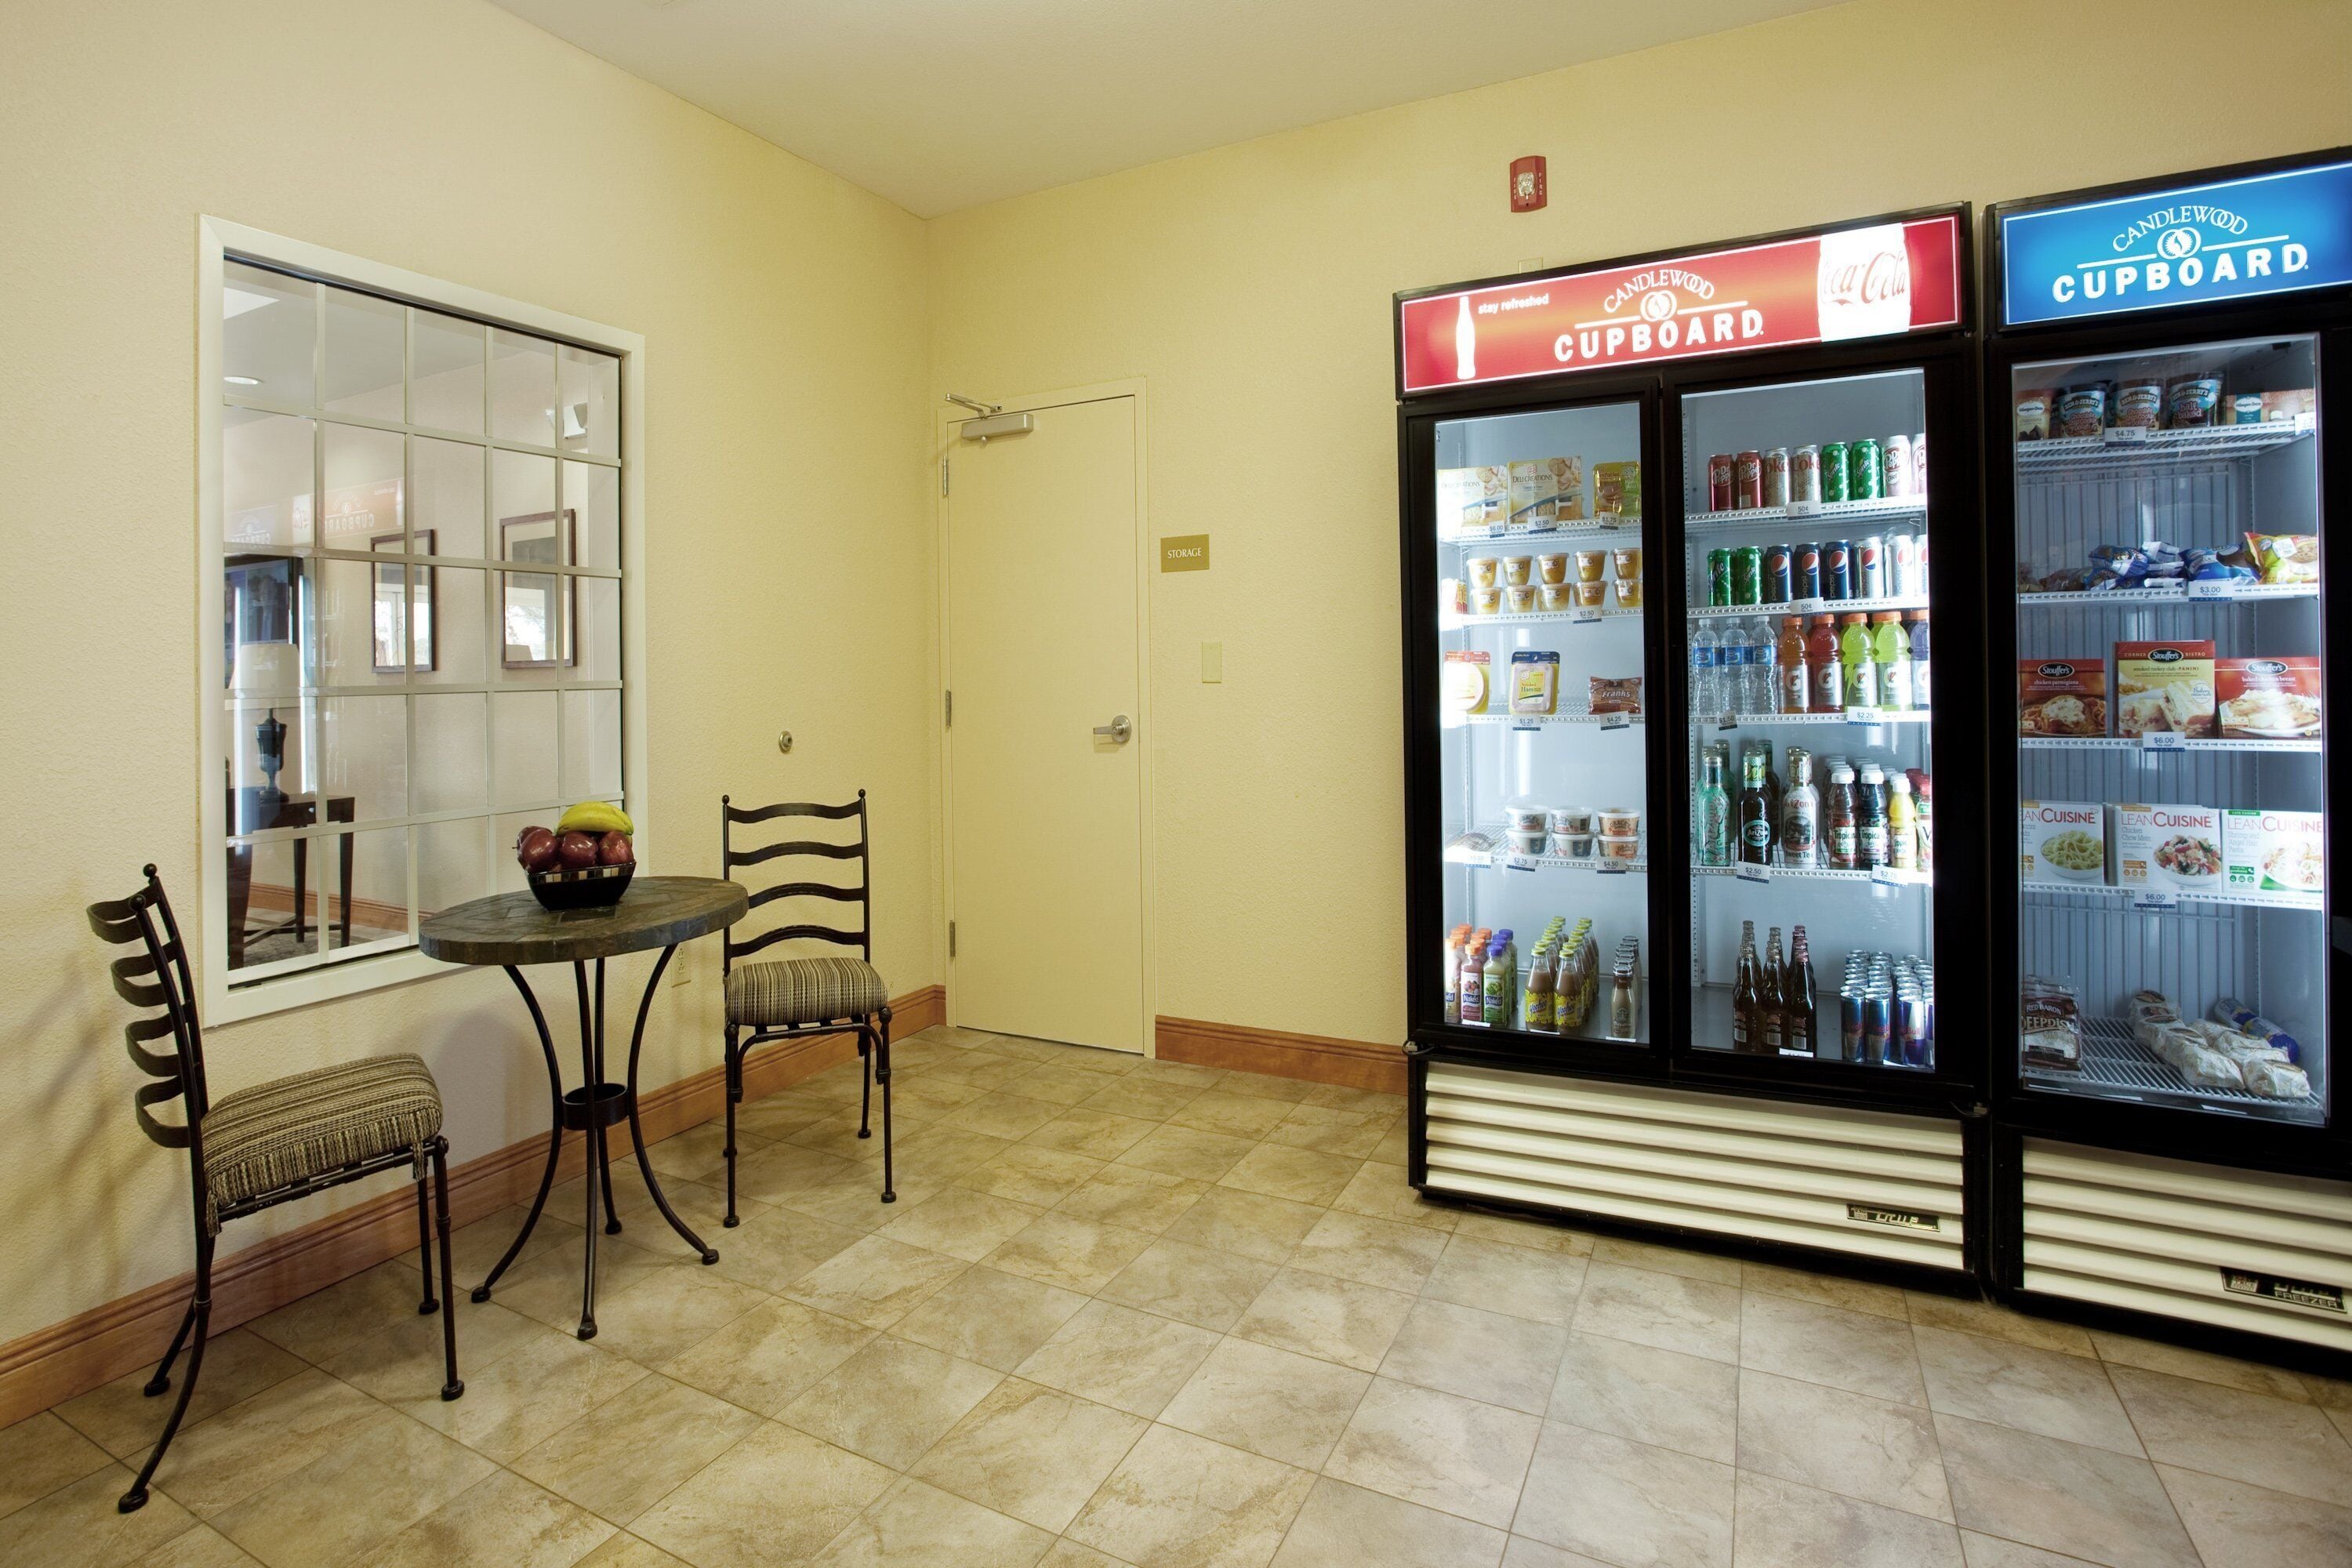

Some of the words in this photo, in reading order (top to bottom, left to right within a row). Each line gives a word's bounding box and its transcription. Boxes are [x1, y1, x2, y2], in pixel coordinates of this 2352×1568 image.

[2112, 205, 2248, 252] CANDLEWOOD
[1604, 269, 1715, 314] CANDLEWOOD
[1478, 301, 1498, 315] stay
[1501, 293, 1549, 311] refreshed
[2186, 388, 2209, 397] JERRY'S
[2138, 394, 2158, 403] JERRY'S
[2180, 402, 2198, 412] half
[2179, 409, 2202, 419] baked
[1747, 462, 1756, 470] Dr
[1766, 459, 1788, 473] oke
[1793, 456, 1820, 472] Coke
[1857, 459, 1870, 478] Sprite
[1721, 466, 1730, 475] Dr
[1826, 462, 1841, 481] Sprite
[1713, 470, 1731, 484] Pepp
[1167, 548, 1201, 559] STORAGE
[1743, 566, 1756, 585] Sprite
[2153, 651, 2180, 661] Stouffer's
[2042, 665, 2070, 676] Stouffer's
[2252, 663, 2283, 673] Stouffer's
[1784, 799, 1813, 809] AriZona
[2041, 808, 2095, 824] CUISINE
[2121, 814, 2152, 826] LEAN
[2153, 812, 2212, 828] CUISINE
[2227, 817, 2261, 830] LEAN
[2262, 816, 2322, 833] CUISINE
[1834, 830, 1855, 841] Tropica
[1861, 830, 1885, 840] Tropica
[1785, 850, 1802, 859] Sweet
[1803, 851, 1813, 859] Tea
[1745, 866, 1761, 874] $2.50
[1881, 870, 1898, 879] $2.75
[1463, 994, 1479, 1003] Naked
[2026, 1004, 2039, 1012] RED
[2039, 1002, 2062, 1015] BARON
[2275, 1291, 2338, 1308] FREEZER
